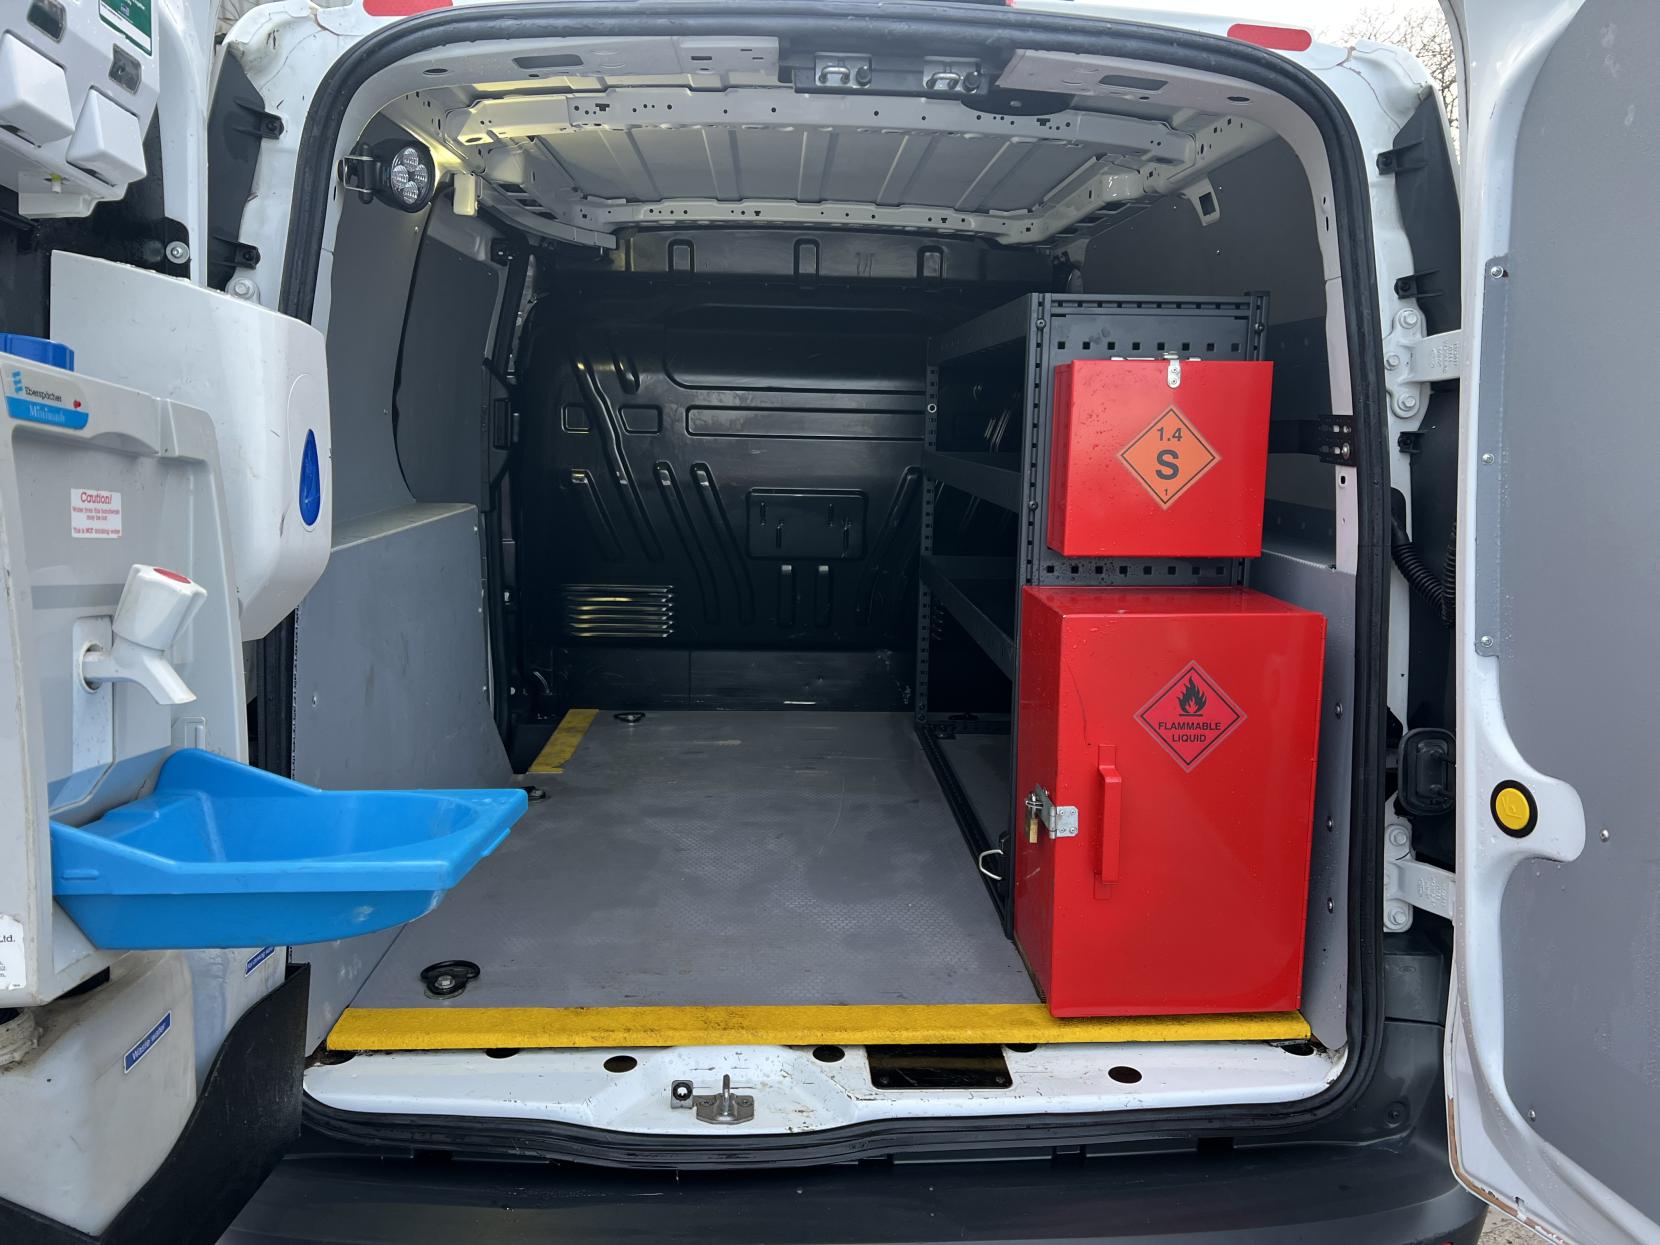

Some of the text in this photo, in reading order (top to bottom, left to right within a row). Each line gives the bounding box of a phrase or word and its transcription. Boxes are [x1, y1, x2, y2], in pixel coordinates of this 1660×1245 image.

[1157, 427, 1183, 442] 1.4
[1156, 449, 1180, 481] S
[80, 492, 112, 504] Caution!
[1163, 488, 1169, 497] 1
[1158, 721, 1222, 731] FLAMMABLE
[1172, 733, 1207, 743] LIQUID
